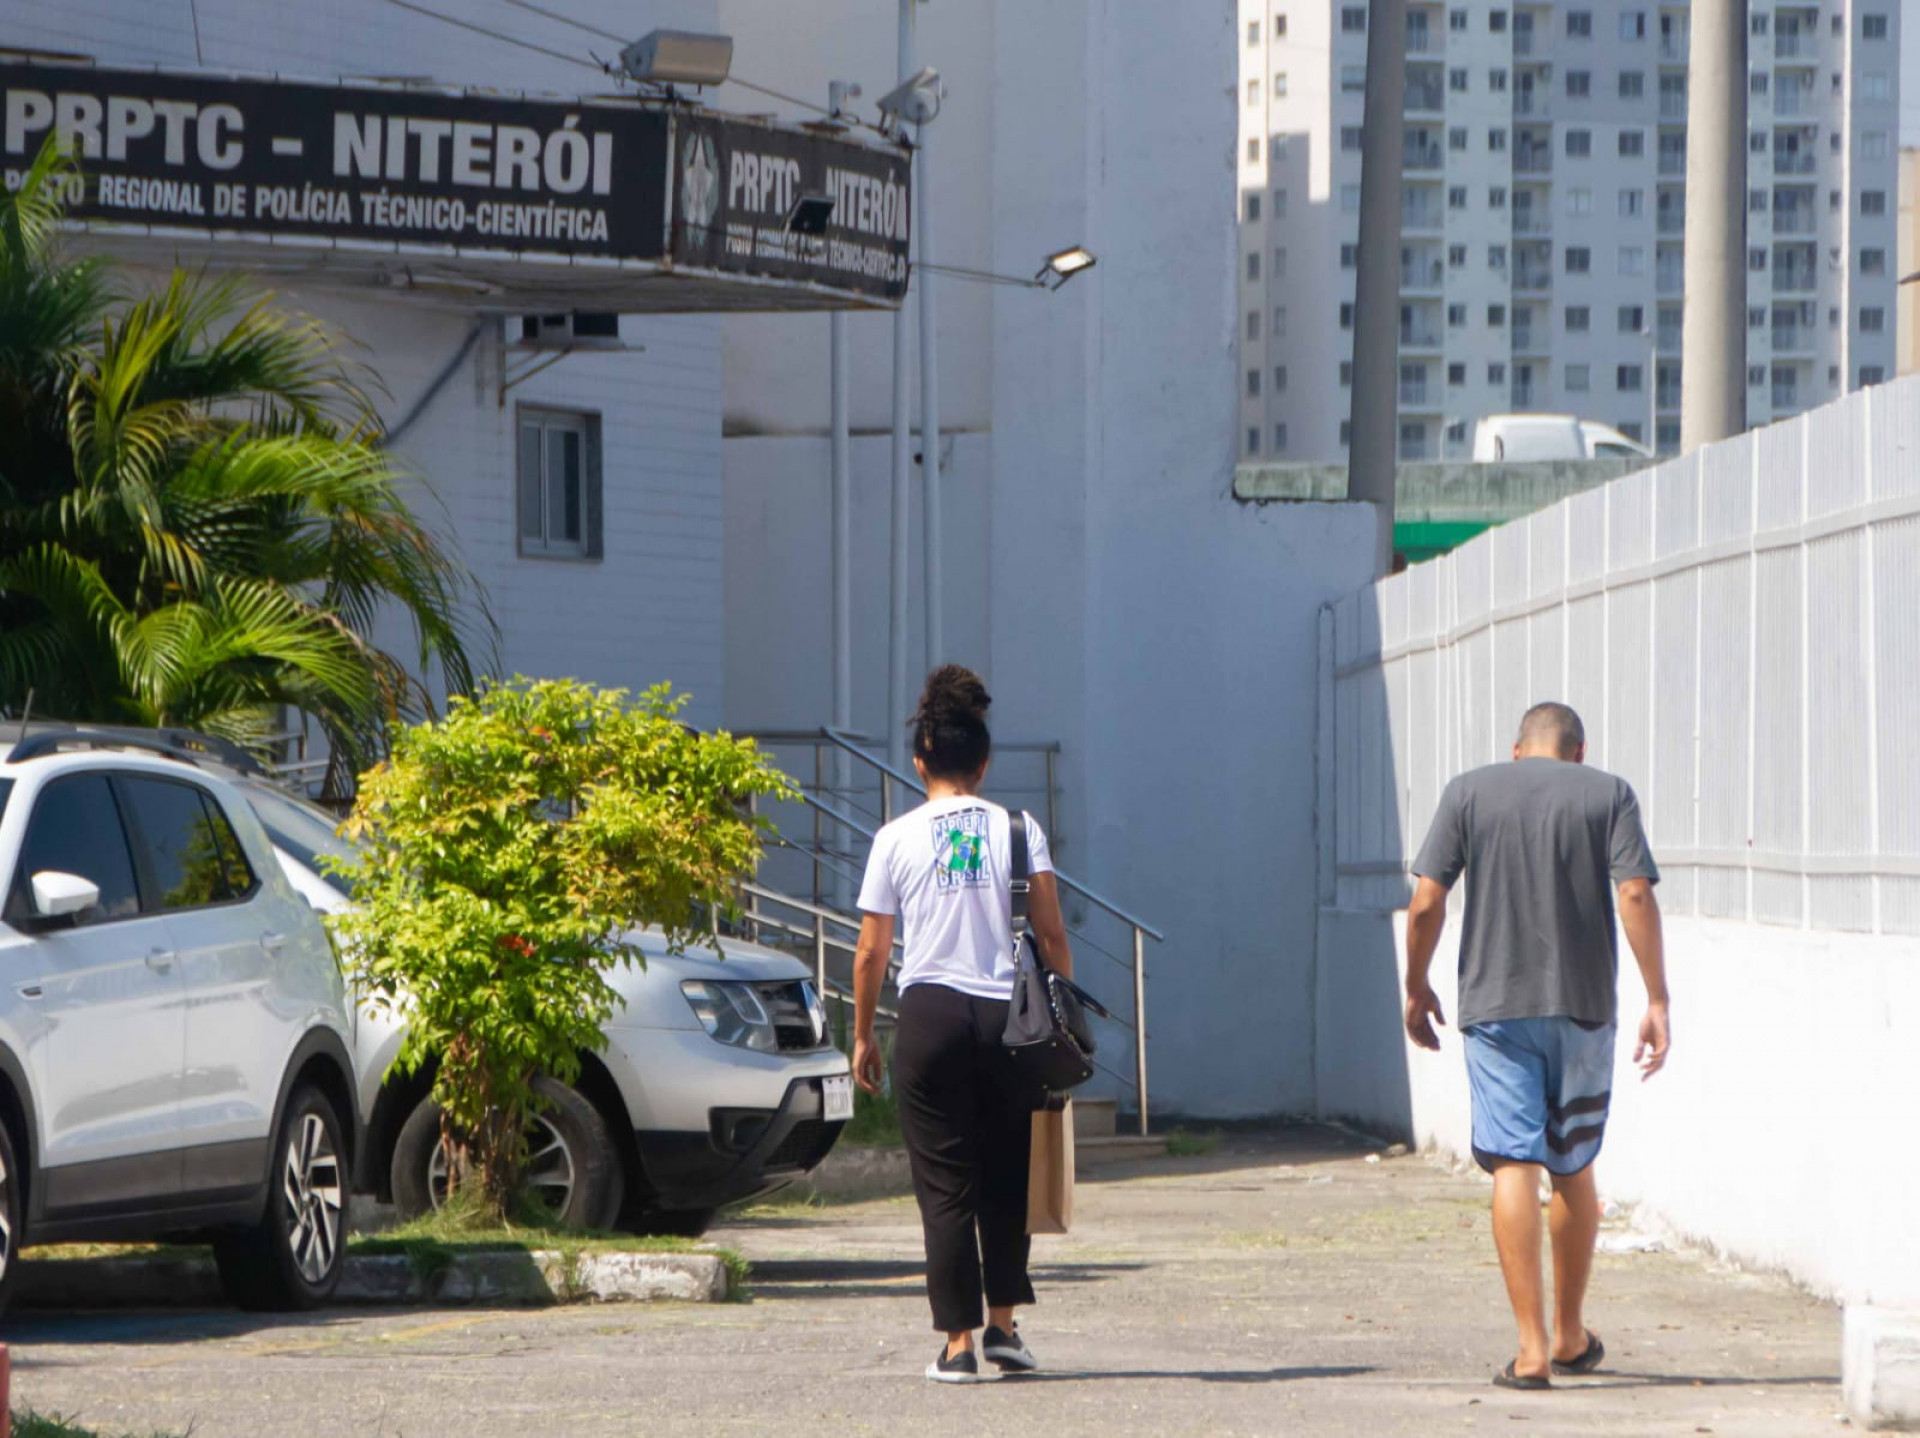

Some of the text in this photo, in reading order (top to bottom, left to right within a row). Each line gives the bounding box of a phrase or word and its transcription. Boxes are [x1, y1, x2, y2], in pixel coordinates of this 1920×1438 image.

[5, 89, 613, 196] PRPTC - NITERÓI
[98, 174, 205, 217] REGIONAL
[213, 183, 246, 218] DE
[254, 180, 351, 225] POLÍCIA
[360, 186, 609, 242] TÉCNICO-CIENTÍFICA
[825, 167, 908, 241] NITERÓI
[936, 857, 991, 888] BRSIL
